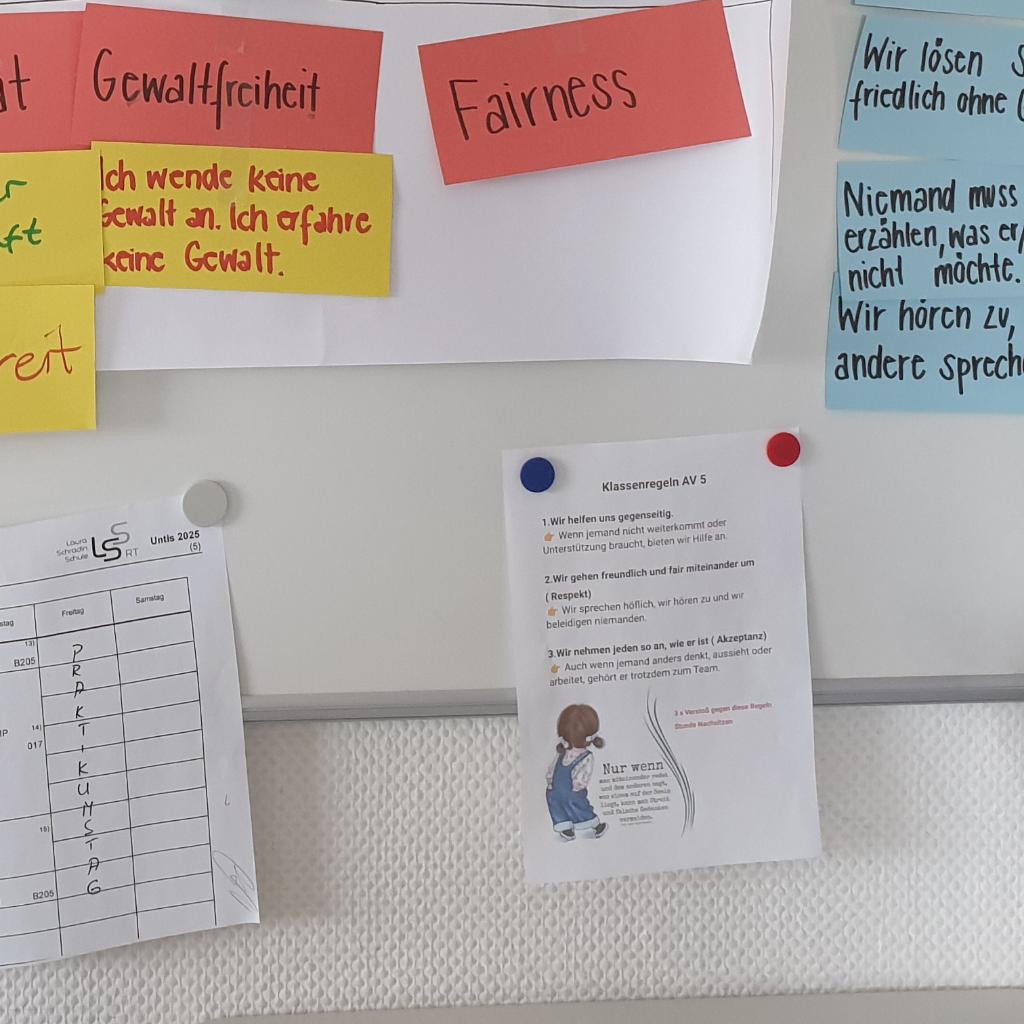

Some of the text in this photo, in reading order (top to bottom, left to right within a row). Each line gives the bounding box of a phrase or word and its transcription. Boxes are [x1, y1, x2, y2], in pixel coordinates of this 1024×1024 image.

[864, 33, 907, 72] Wir
[920, 38, 983, 77] lösen
[93, 48, 320, 129] Gewaltfreiheit
[849, 80, 945, 121] friedlich
[957, 86, 1008, 115] ohne
[449, 68, 637, 140] Fairness
[100, 156, 320, 193] Ich wende keine
[844, 179, 1018, 217] Niemand muss
[185, 207, 221, 230] an.
[229, 202, 268, 232] Ich
[276, 206, 372, 245] erfahre
[949, 224, 990, 249] was
[184, 240, 285, 276] Gewalt.
[848, 252, 1021, 292] nicht möchte.
[838, 295, 1015, 342] Wir hören zu,
[834, 342, 1024, 395] andere sprech
[602, 475, 707, 492] Klassenregeln AV 5
[559, 519, 727, 540] Wenn jemand nicht weiterkommt oder
[568, 514, 597, 524] helfen
[599, 514, 616, 523] uns
[618, 510, 674, 523] gegenseitig.
[150, 530, 201, 546] Untis 2025
[543, 542, 606, 555] Unterstützung
[609, 539, 645, 550] braucht,
[647, 537, 675, 547] bieten
[677, 536, 690, 544] wir
[693, 533, 713, 542] Hilfe
[571, 572, 599, 583] gehen
[601, 568, 647, 580] freundlich
[649, 566, 666, 576] und
[669, 564, 684, 575] fair
[686, 560, 738, 573] miteinander
[740, 558, 755, 567] um
[61, 607, 85, 617] Freitag
[135, 593, 165, 604] Samstag
[546, 614, 647, 629] beleidigen niemanden.
[573, 646, 611, 657] nehmen
[612, 643, 638, 655] jeden
[640, 643, 652, 651] so
[653, 641, 667, 651] an,
[669, 639, 685, 648] wie
[687, 638, 696, 647] er
[697, 637, 709, 646] ist
[603, 760, 664, 774] Nur wenn
